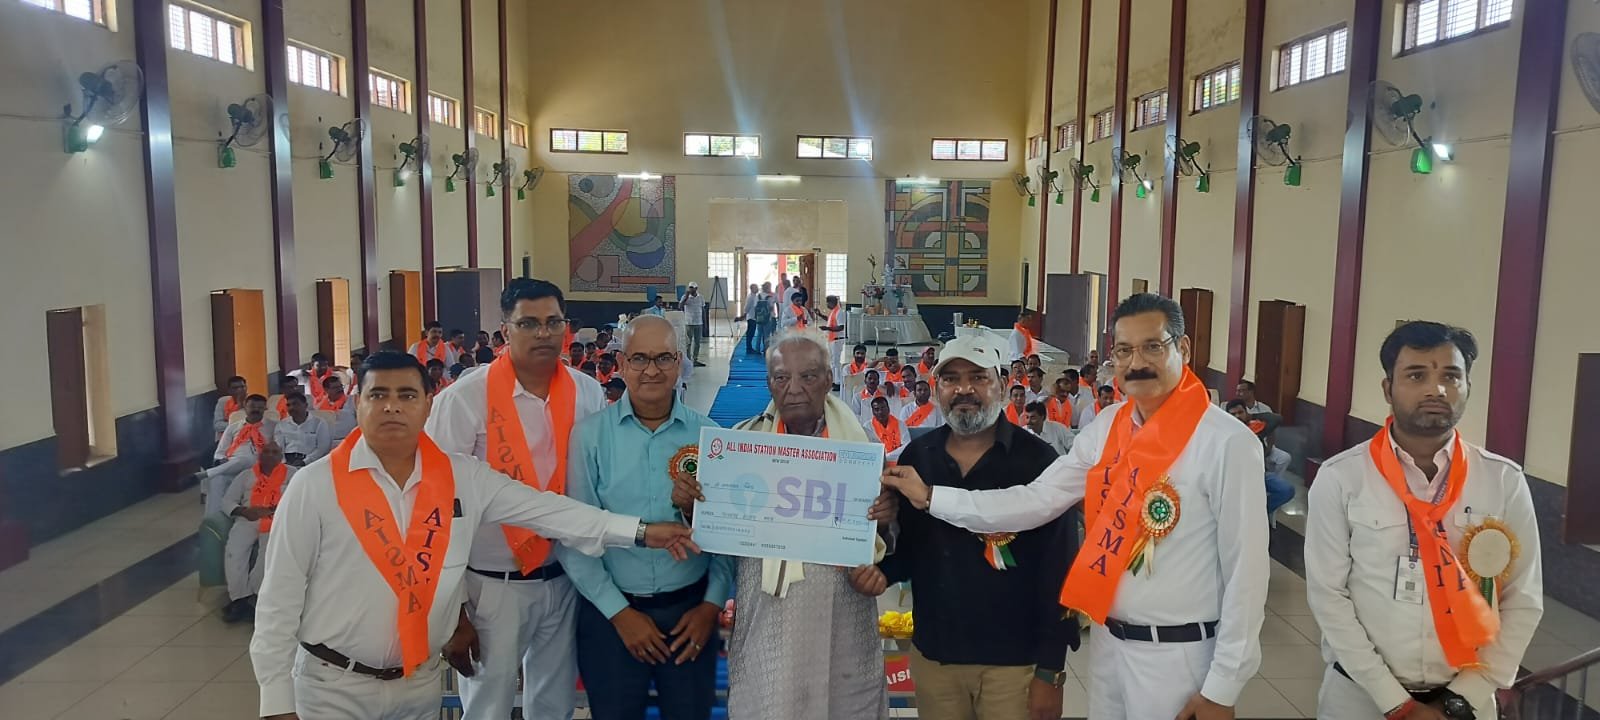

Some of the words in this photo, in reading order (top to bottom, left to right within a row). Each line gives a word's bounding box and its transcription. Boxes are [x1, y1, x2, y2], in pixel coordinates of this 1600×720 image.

[726, 441, 736, 452] ALL
[738, 442, 753, 453] INDIA
[754, 444, 777, 456] STATION
[778, 446, 800, 458] MASTER
[801, 449, 837, 462] ASSOCIATION
[774, 476, 848, 521] SBI
[1088, 466, 1140, 576] AISMA
[416, 506, 443, 584] AIS
